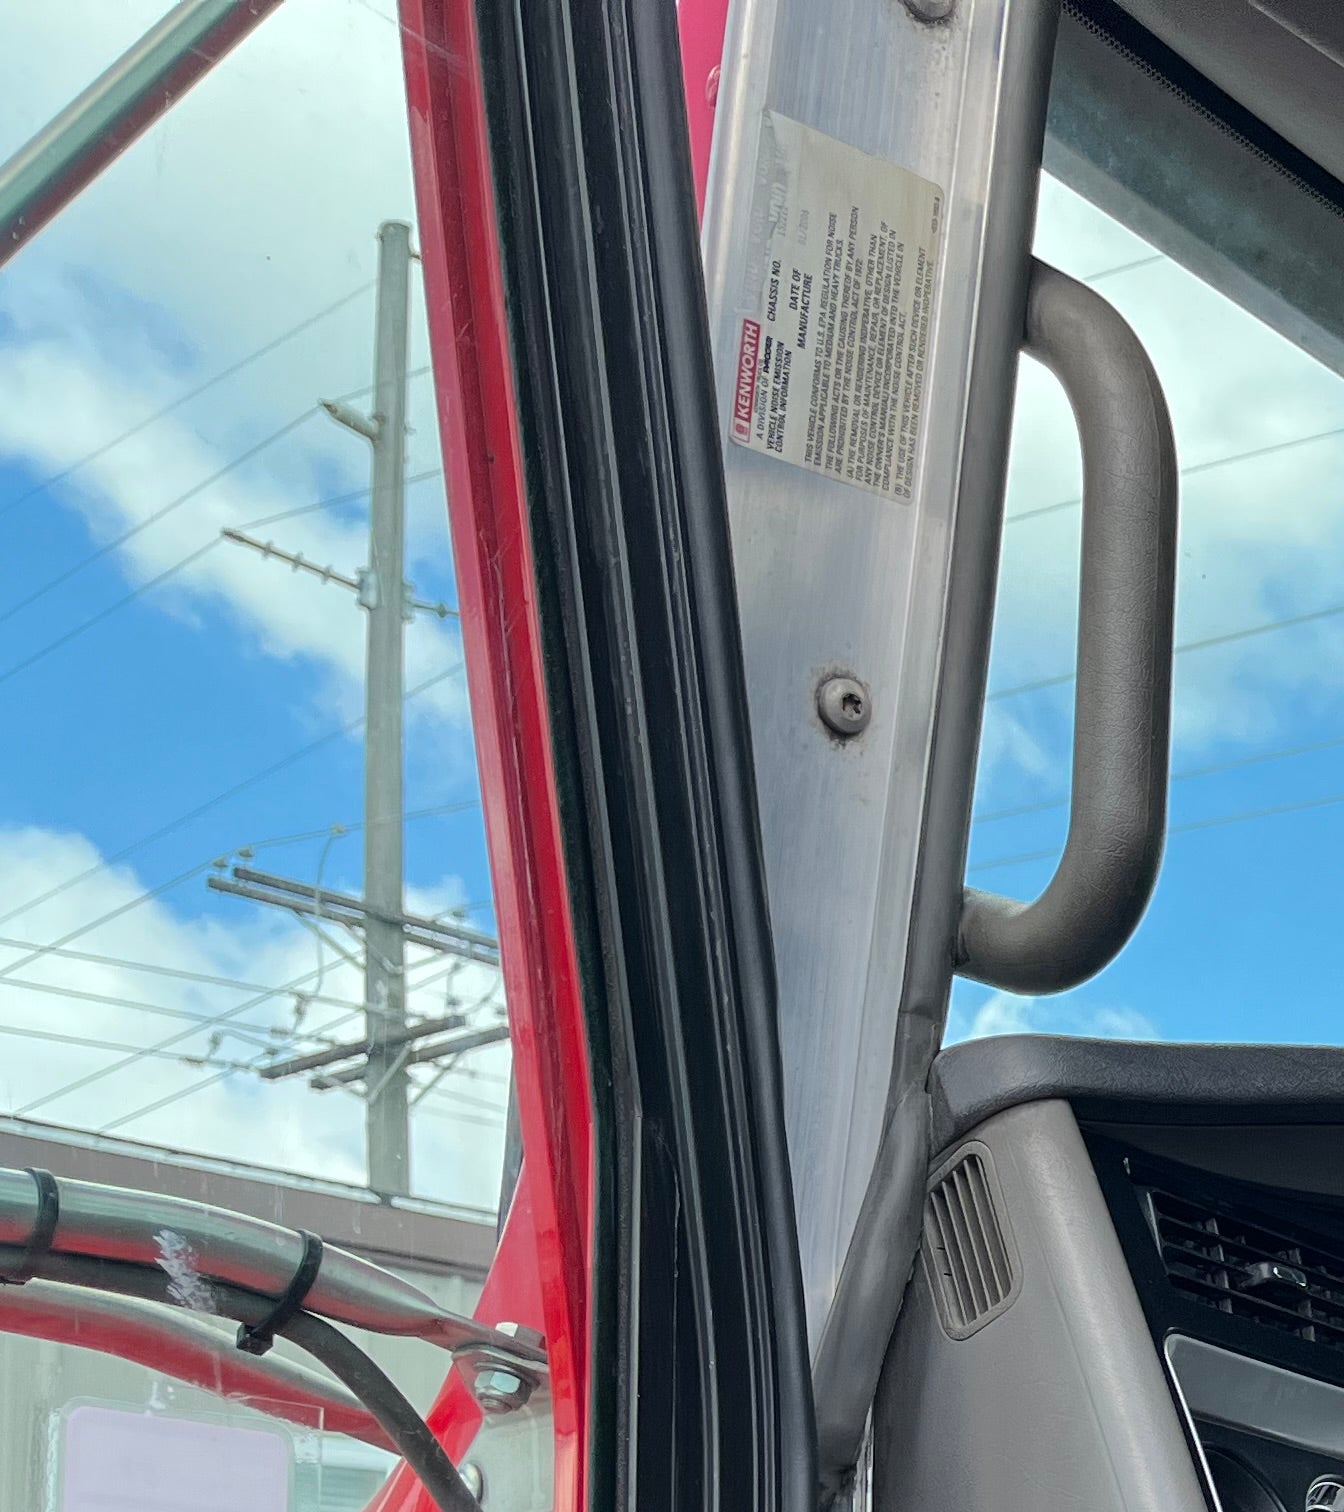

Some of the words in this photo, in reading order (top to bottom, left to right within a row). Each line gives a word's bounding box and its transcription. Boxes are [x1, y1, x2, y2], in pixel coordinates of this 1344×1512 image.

[828, 212, 836, 238] NOISE
[849, 205, 859, 240] PERSON
[890, 229, 896, 240] IN
[826, 238, 834, 256] FOR
[847, 241, 855, 259] ANY
[869, 233, 877, 257] THAN
[897, 241, 904, 252] IN
[772, 257, 781, 276] NO.
[793, 266, 801, 282] OF
[846, 259, 853, 272] BY
[866, 258, 875, 287] OTHER
[894, 252, 903, 287] VEHICLE
[916, 246, 925, 285] ELEMENT
[790, 282, 800, 310] DATE
[821, 256, 832, 309] REGULATION
[831, 272, 839, 301] HEAVY
[842, 273, 852, 309] THEREOF
[854, 277, 861, 290] OF
[883, 272, 891, 304] DESIGN
[915, 285, 921, 298] OR
[768, 277, 779, 322] CHASSIS
[797, 272, 812, 349] MANUFACTURE
[873, 297, 880, 309] OR
[881, 304, 888, 316] OF
[912, 299, 920, 328] DEVICE
[848, 309, 858, 348] CONTROL
[890, 304, 898, 326] INTO
[825, 322, 834, 358] MEDIUM
[838, 310, 848, 349] CAUSING
[878, 317, 887, 356] ELEMENT
[909, 329, 917, 352] SUCH
[918, 314, 928, 358] RENDERED
[774, 340, 784, 384] EMISSION
[816, 346, 823, 358] TO
[845, 348, 853, 375] NOISE
[876, 356, 883, 369] OR
[884, 326, 895, 390] INCORPORATED
[895, 331, 904, 369] CONTROL
[737, 321, 758, 419] KENWORTH
[824, 359, 831, 371] TO
[835, 367, 842, 379] OR
[855, 344, 866, 393] RENDERING
[907, 353, 915, 378] AFTER
[917, 359, 923, 371] OR
[762, 376, 768, 387] OF
[780, 349, 792, 411] INFORMATION
[811, 359, 821, 407] CONFORMS
[873, 370, 882, 399] DEVICE
[892, 370, 900, 395] NOISE
[913, 372, 922, 412] REMOVED
[758, 389, 767, 430] DIVISION
[770, 386, 779, 413] NOISE
[819, 372, 830, 423] APPLICABLE
[842, 392, 849, 405] BY
[854, 393, 861, 406] OR
[903, 379, 912, 413] VEHICLE
[808, 407, 816, 441] VEHICLE
[850, 407, 860, 447] REMOVAL
[862, 407, 869, 419] OF
[869, 400, 879, 439] CONTROL
[888, 413, 896, 436] WITH
[901, 414, 909, 433] THIS
[910, 413, 918, 435] BEEN
[757, 431, 763, 439] A
[767, 414, 777, 450] VEHICLE
[776, 412, 786, 453] CONTROL
[828, 404, 838, 453] FOLLOWING
[837, 405, 848, 455] PROHIBITED
[858, 419, 868, 464] PURPOSES
[900, 434, 907, 445] OF
[805, 443, 813, 463] THIS
[814, 423, 825, 466] EMISSION
[848, 448, 856, 464] THE
[866, 439, 875, 465] NOISE
[883, 437, 894, 491] COMPLIANCE
[896, 464, 904, 480] THE
[905, 455, 913, 487] DESIGN
[904, 487, 910, 498] OF
